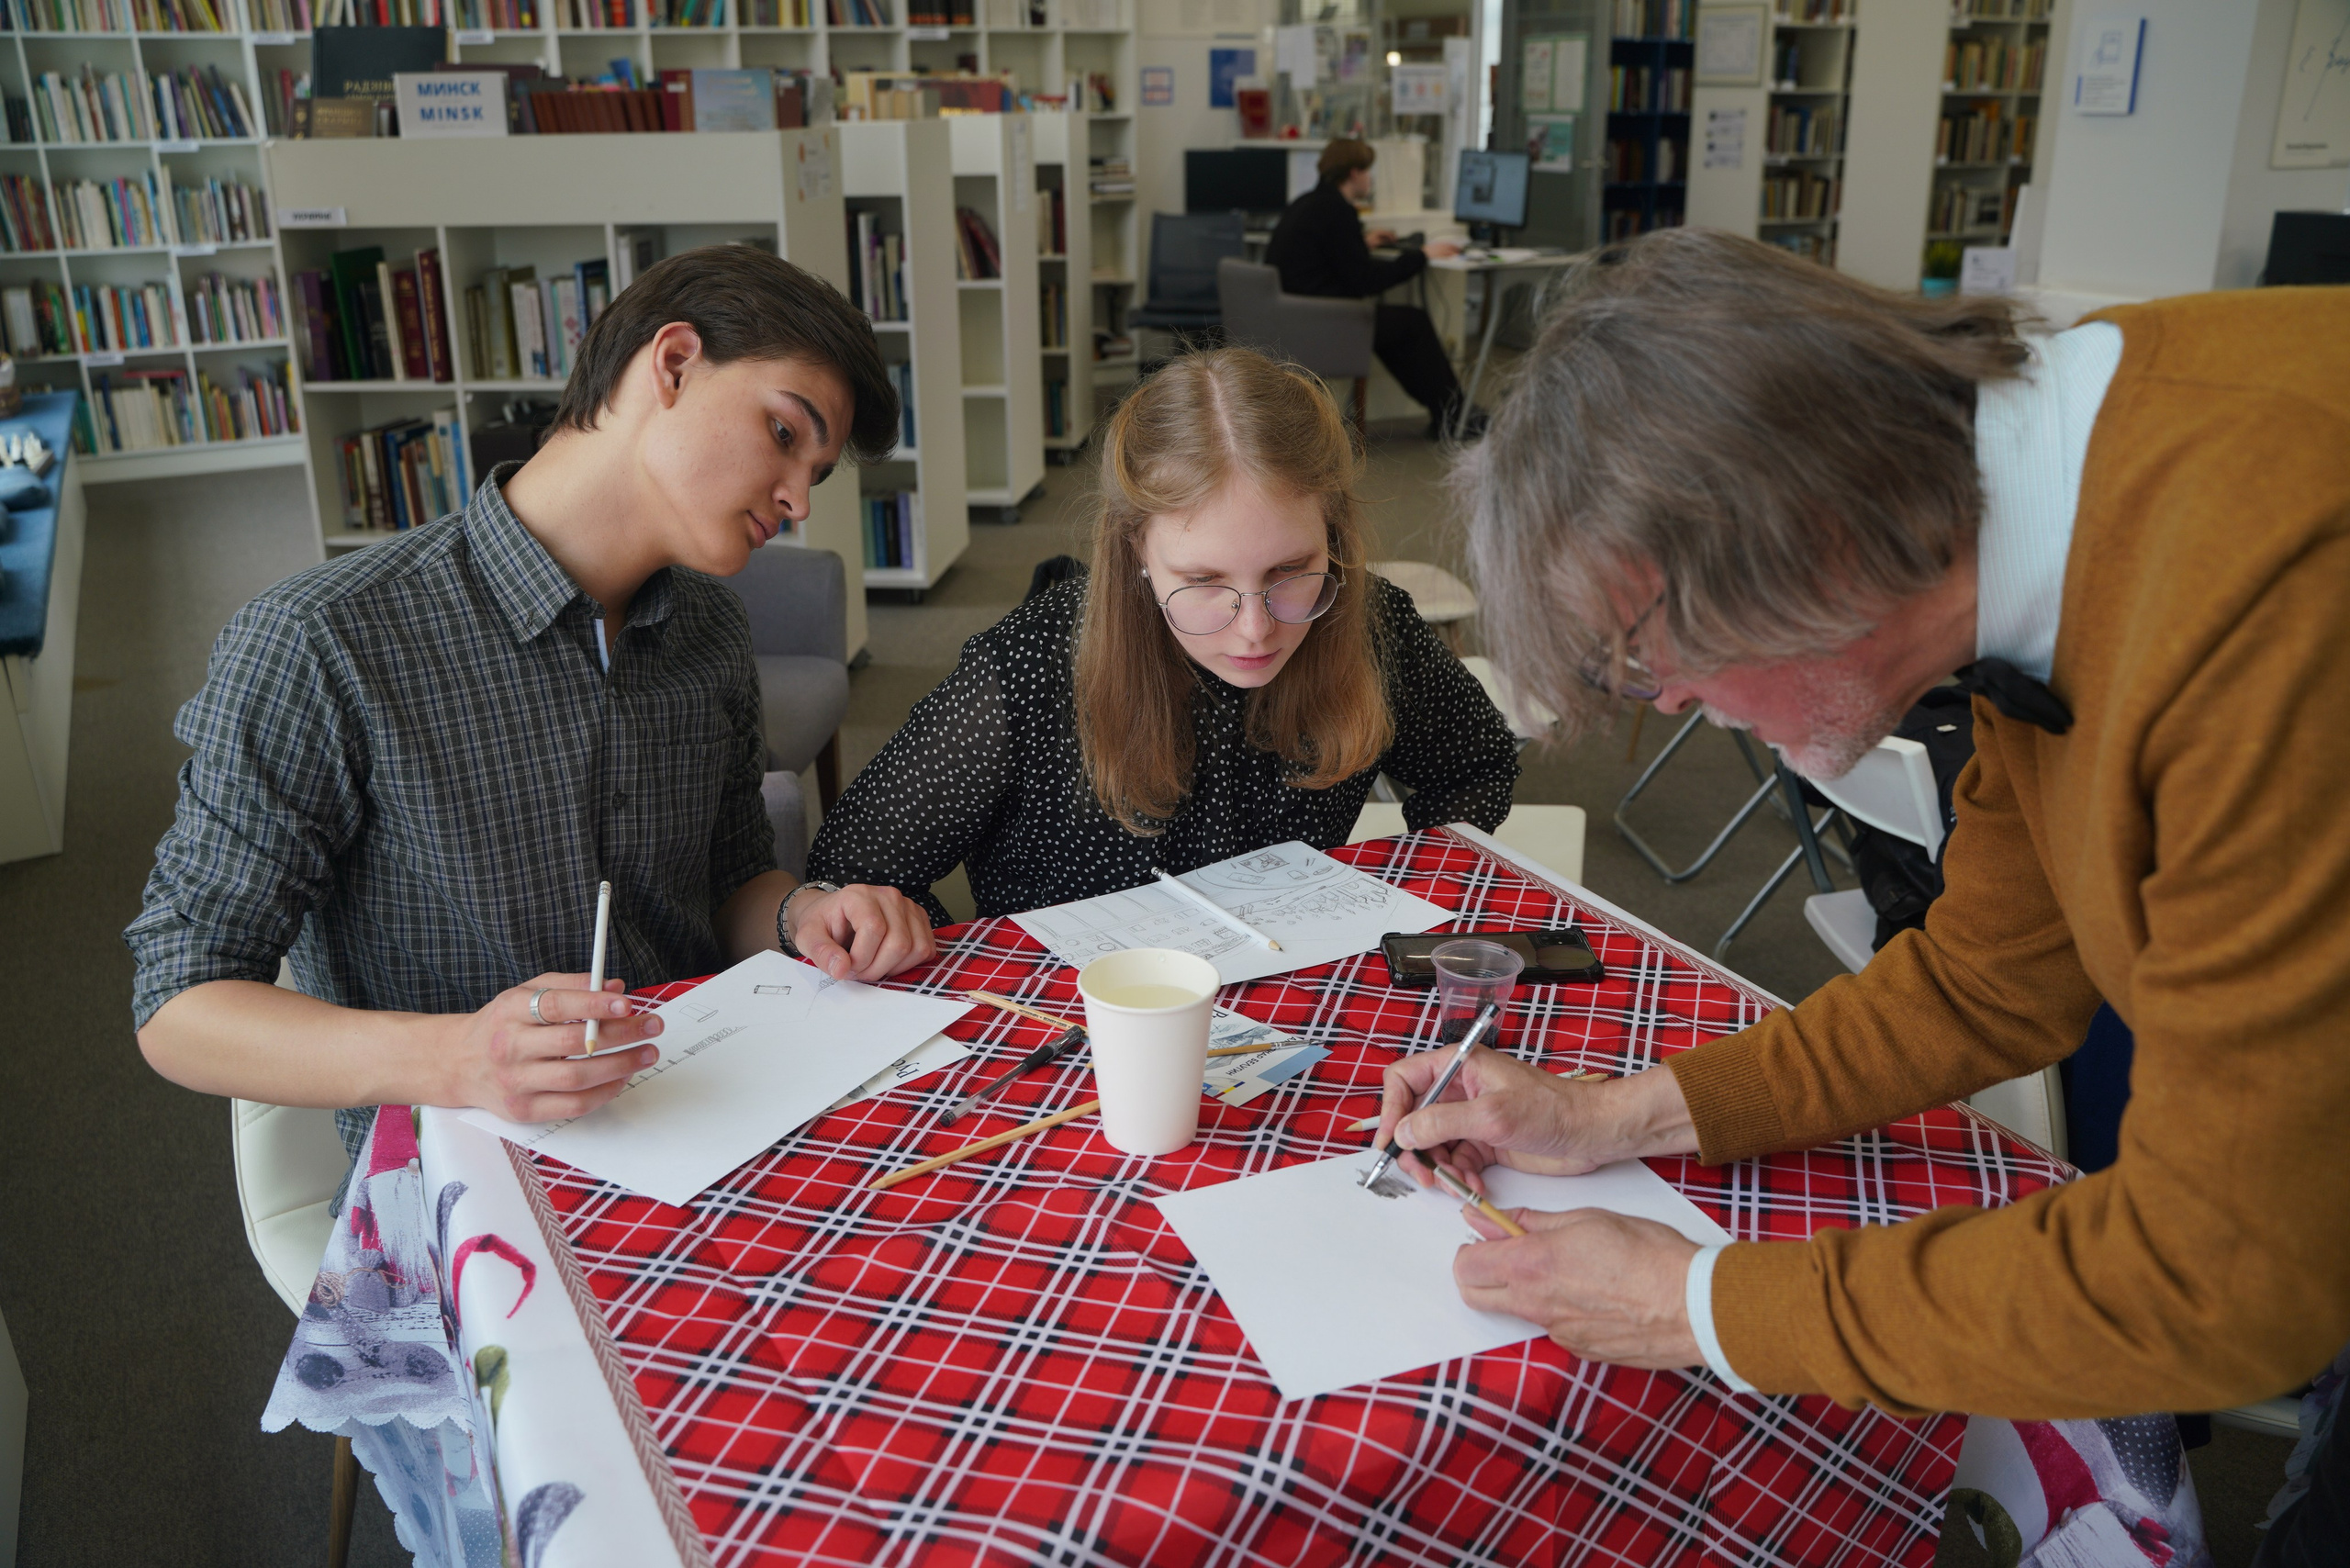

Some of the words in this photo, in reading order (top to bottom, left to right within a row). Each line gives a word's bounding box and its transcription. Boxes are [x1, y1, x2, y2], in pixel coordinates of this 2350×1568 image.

[418, 82, 481, 96] МИНСК
[420, 106, 484, 121] MINSK
[1225, 1058, 1259, 1076] БЕЛУГИН
